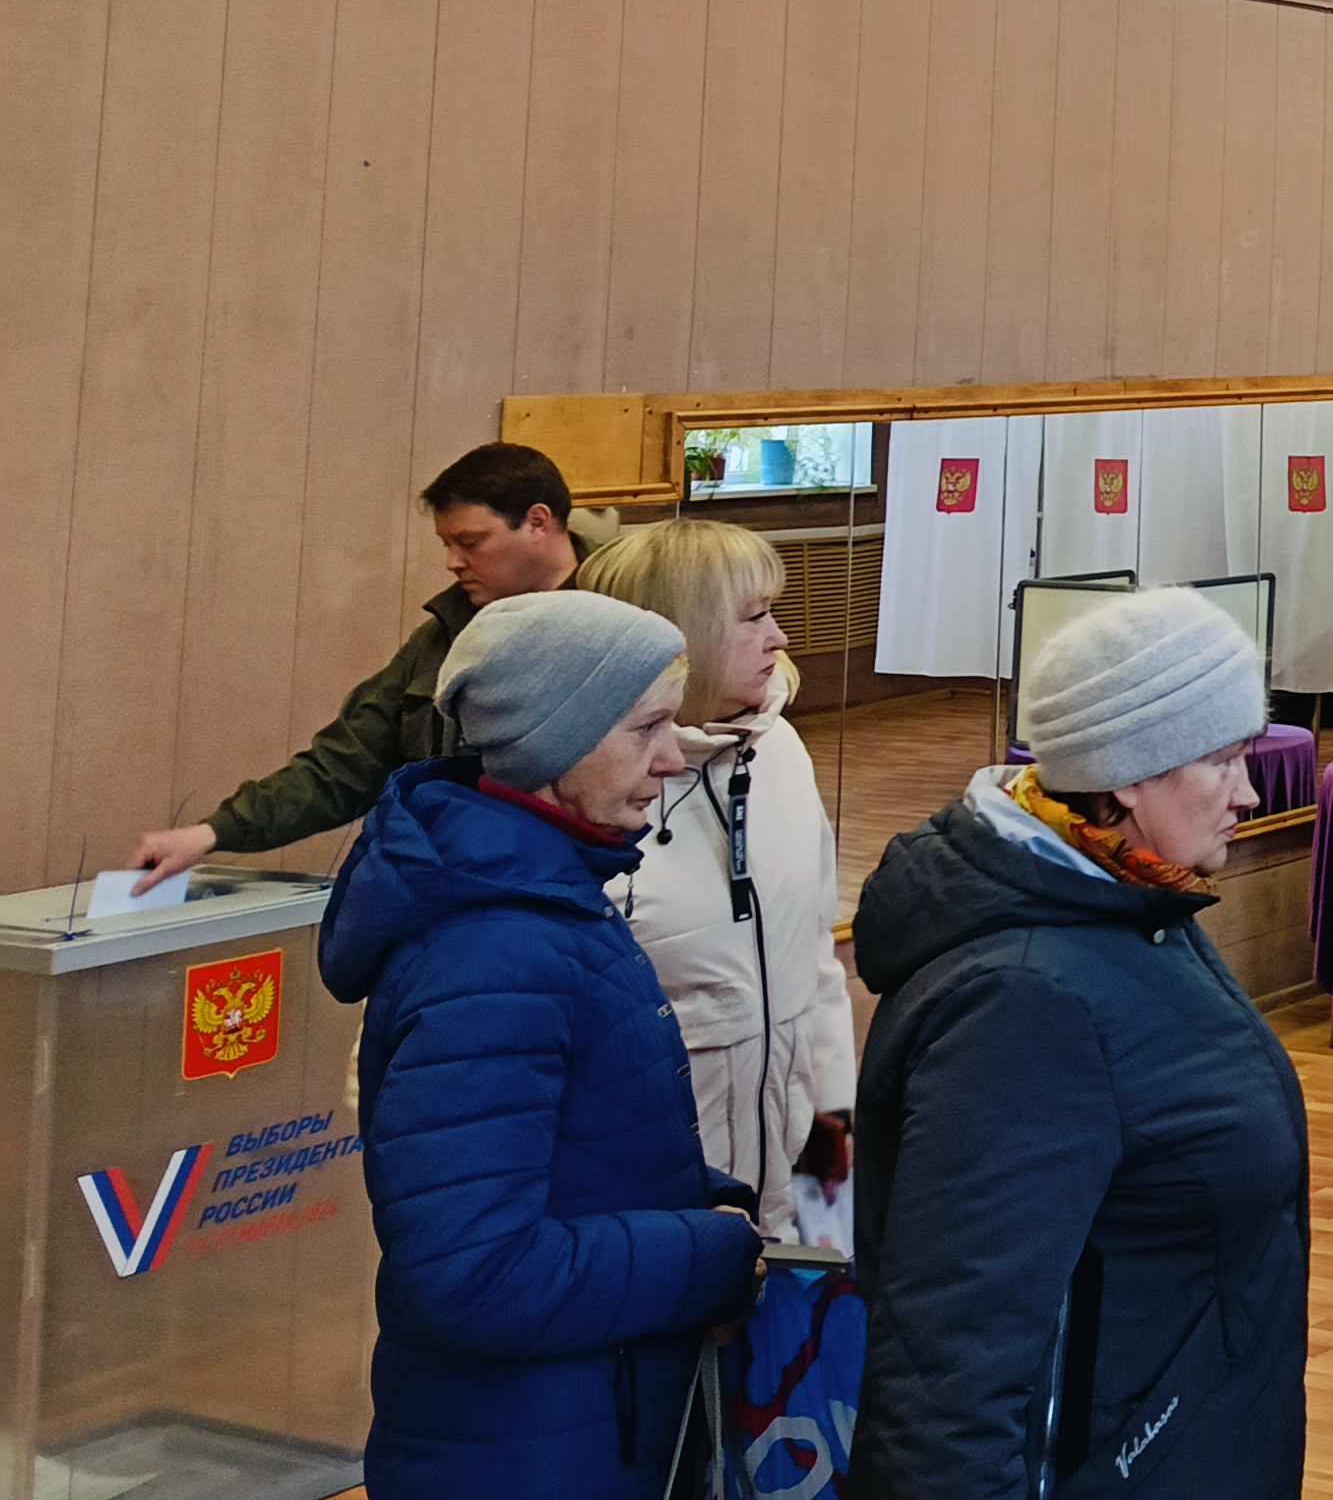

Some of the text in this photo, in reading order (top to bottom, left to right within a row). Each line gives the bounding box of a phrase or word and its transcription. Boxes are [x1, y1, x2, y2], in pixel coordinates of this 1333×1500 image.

[225, 1110, 335, 1158] ВЫБОРЫ
[211, 1135, 365, 1193] ПРЕЗИДЕНТА
[197, 1183, 298, 1230] РОССИИ
